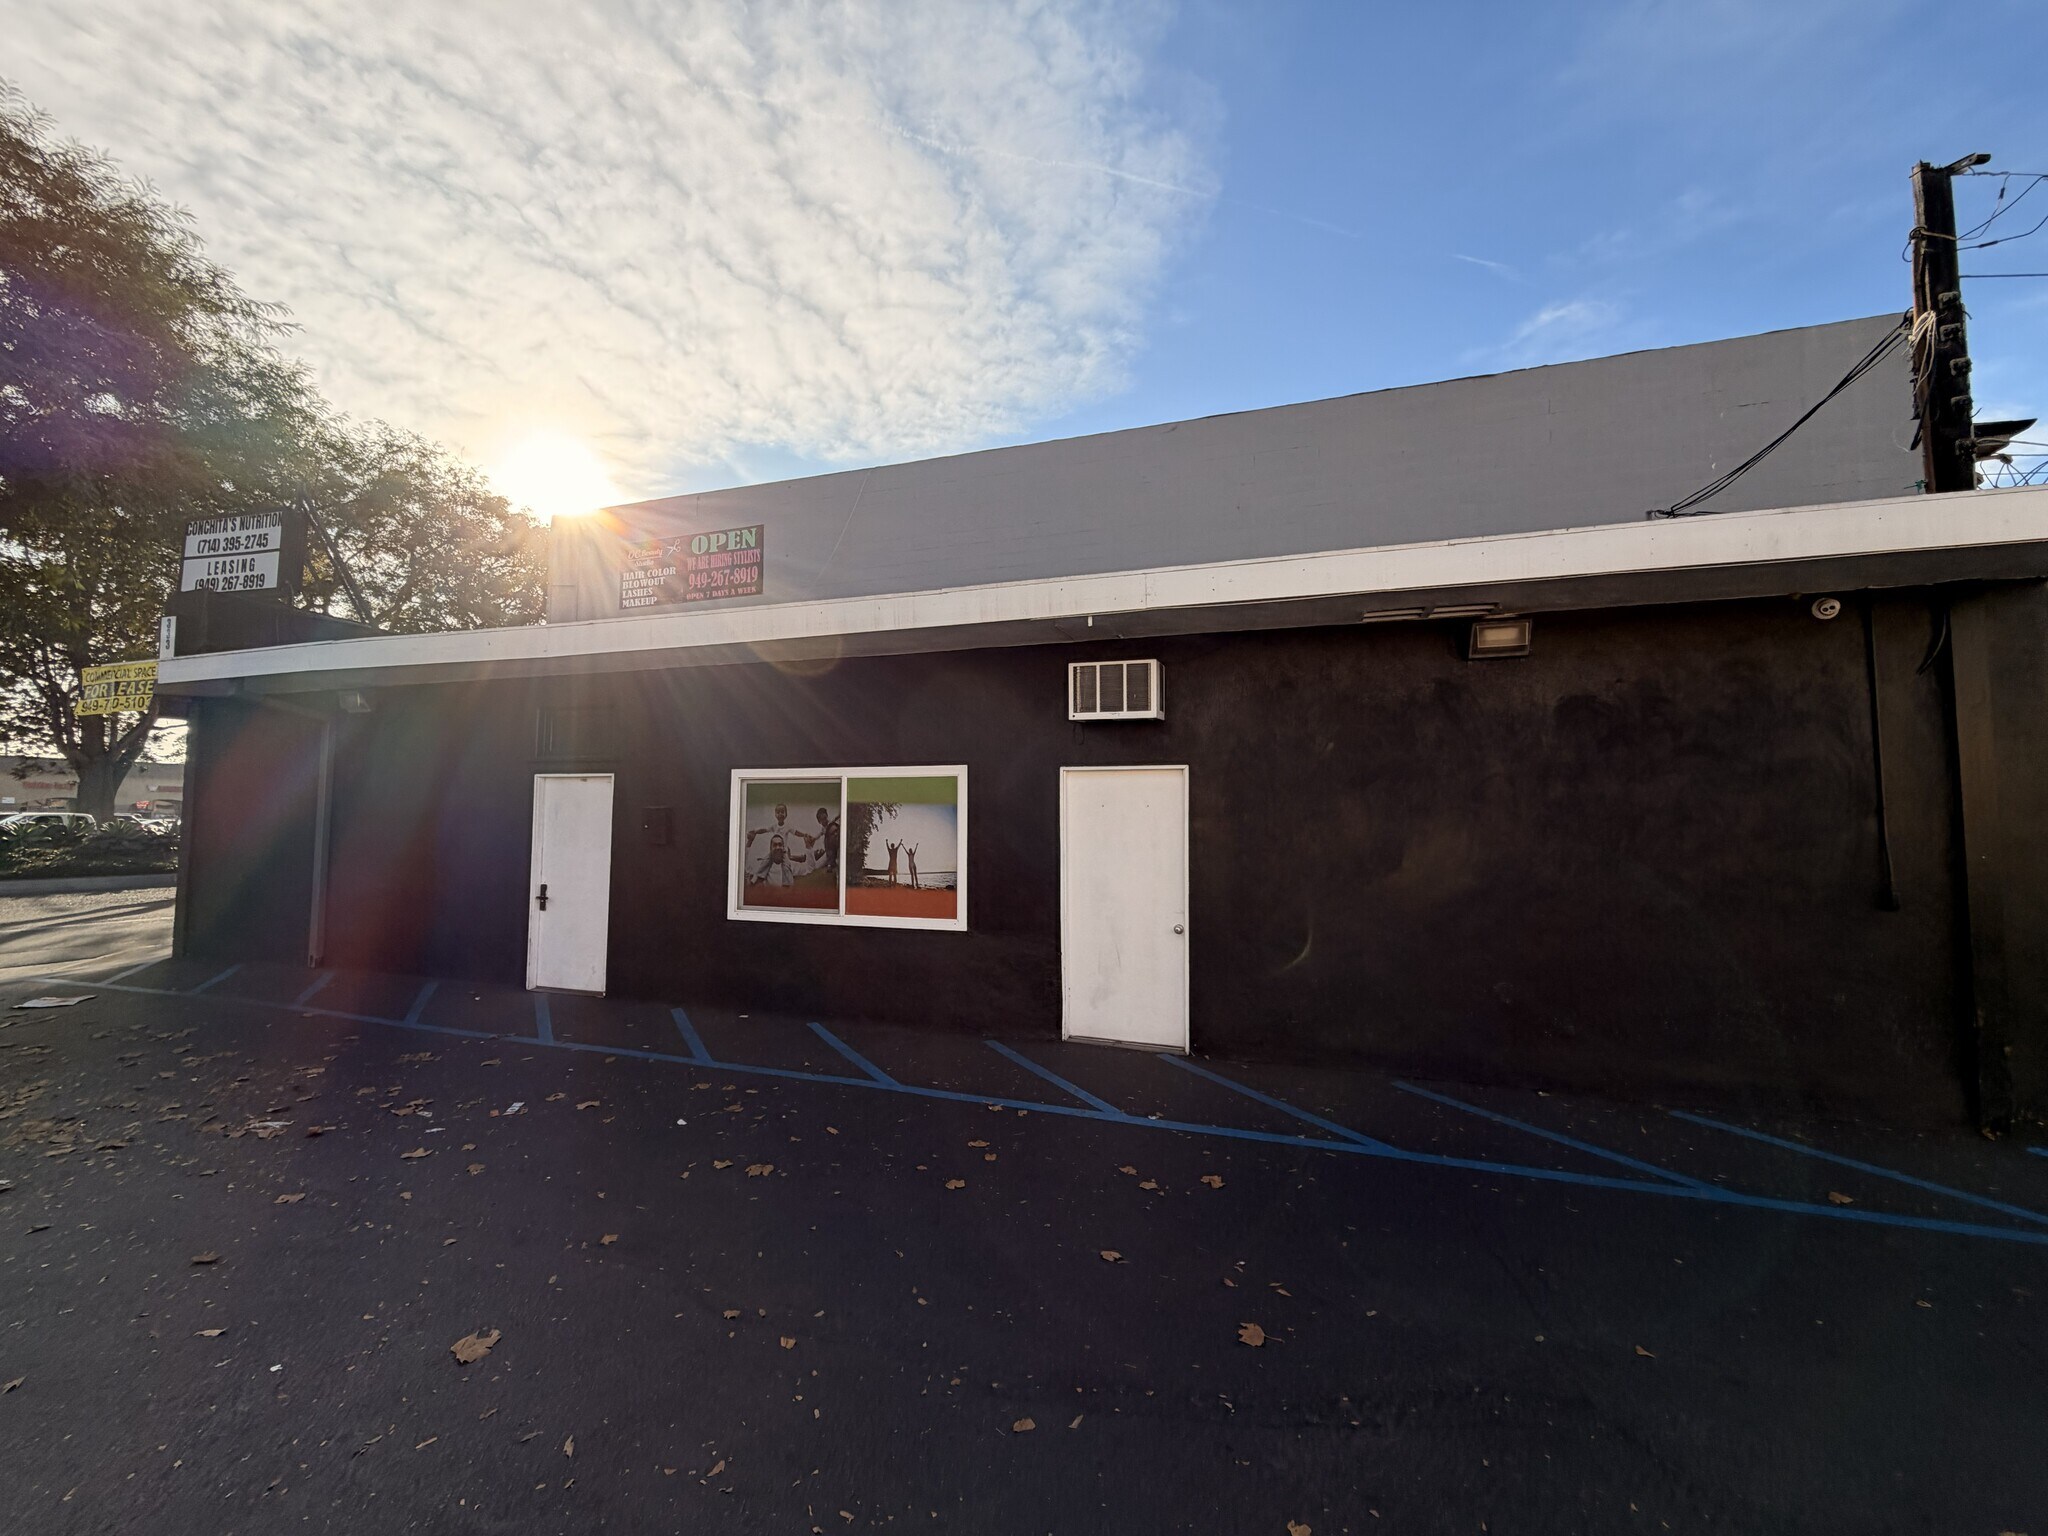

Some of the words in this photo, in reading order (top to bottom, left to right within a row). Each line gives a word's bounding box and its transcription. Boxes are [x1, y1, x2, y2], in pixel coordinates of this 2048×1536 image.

[186, 517, 237, 536] CONCHITA'S
[197, 539, 220, 554] (714)
[222, 533, 269, 552] 395-2745
[691, 528, 757, 555] OPEN
[207, 558, 256, 577] LEASING
[698, 554, 709, 570] ARE
[710, 552, 732, 568] HIRING
[733, 548, 761, 565] STYLISTS
[221, 573, 266, 591] 267-8919
[622, 569, 645, 581] HAIR
[647, 566, 677, 578] COLOR
[688, 565, 759, 590] 949-267-8919
[622, 577, 666, 590] BLOWOUT
[686, 592, 704, 600] OPEN
[712, 589, 729, 598] DAYS
[737, 585, 757, 595] WEEK
[622, 587, 653, 599] LASHES
[622, 596, 658, 608] MAKEUP
[133, 666, 157, 678] SPACE
[84, 684, 108, 699] FOR
[112, 680, 155, 697] EASE
